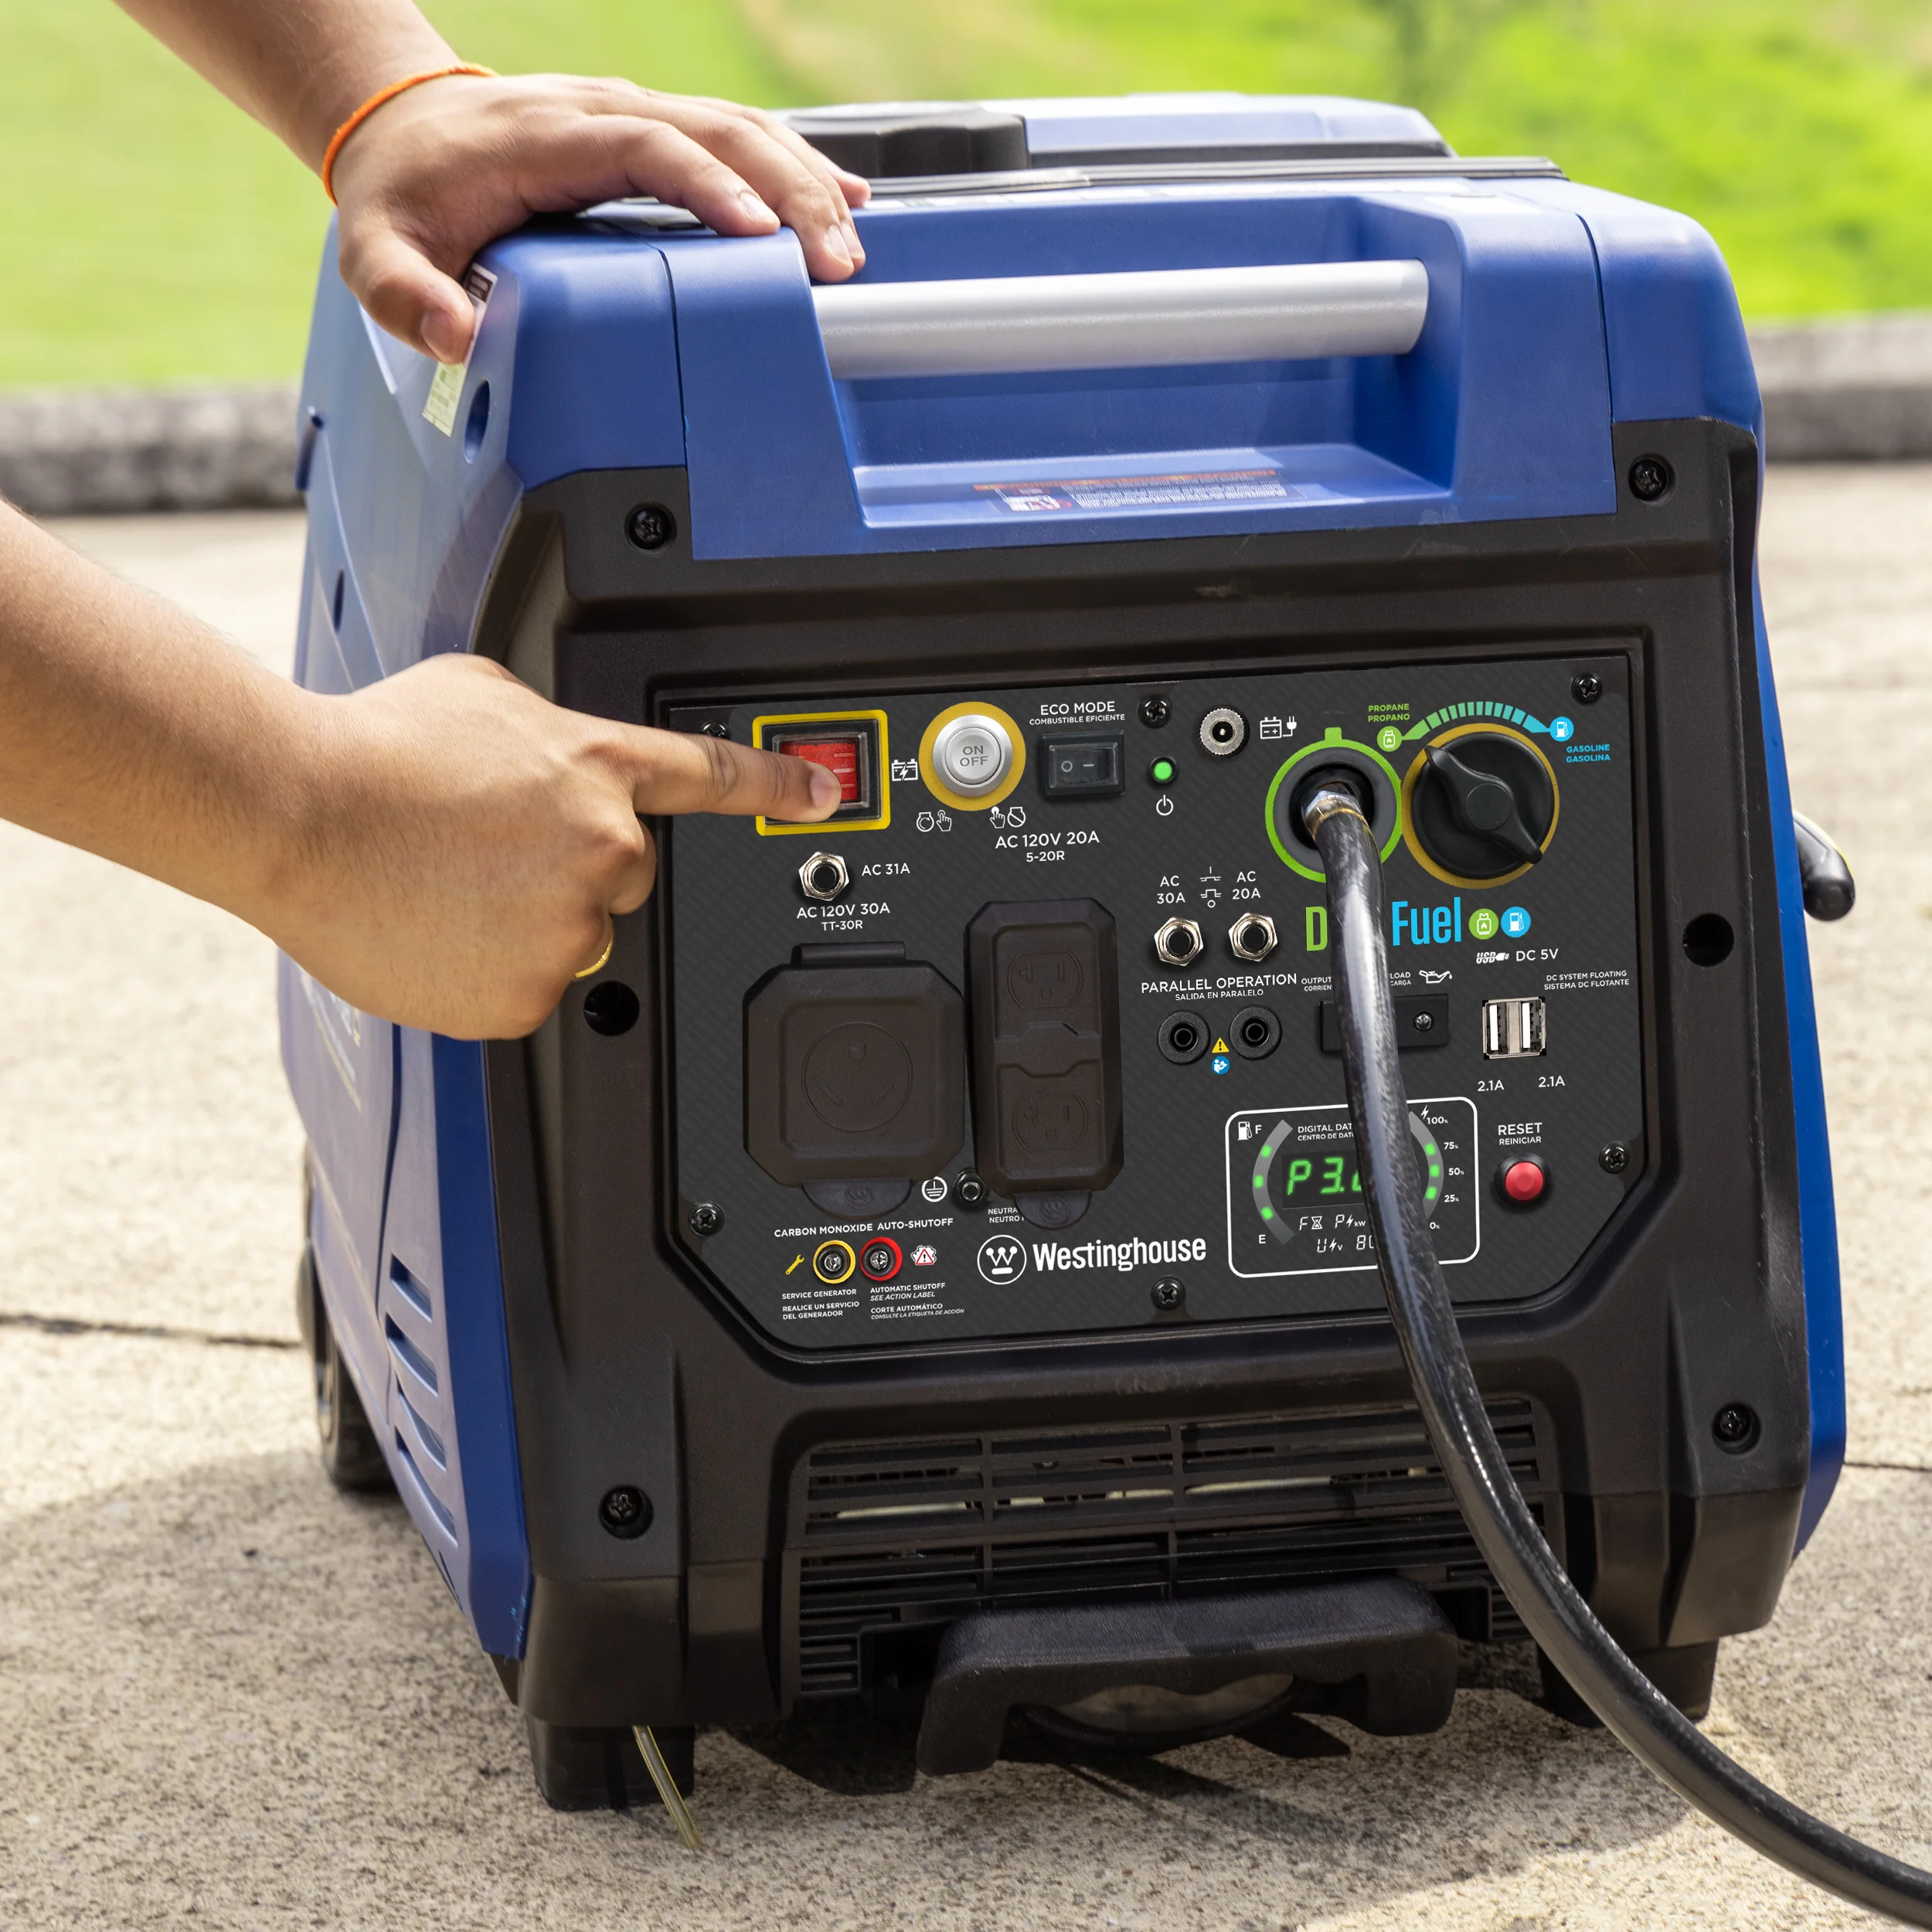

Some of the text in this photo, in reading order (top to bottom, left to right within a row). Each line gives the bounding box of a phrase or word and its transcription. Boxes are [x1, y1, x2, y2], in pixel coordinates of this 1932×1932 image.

[1041, 701, 1115, 715] ECO MODE
[1029, 716, 1083, 725] COMBUSTIBLE
[1369, 713, 1410, 722] PROPANO
[963, 745, 983, 755] ON
[1566, 744, 1609, 753] GASOLINE
[961, 756, 988, 766] OFF
[1566, 754, 1611, 763] GASOLINA
[995, 831, 1100, 849] AC 120V 20A
[1026, 851, 1064, 862] 5-20R
[862, 863, 910, 876] AC 31A
[1160, 876, 1179, 887] AC
[1237, 871, 1256, 883] AC
[1157, 893, 1185, 904] 30A
[1233, 888, 1260, 900] 20A
[797, 903, 890, 918] AC 120V 30A
[821, 920, 862, 930] TT-30R
[1392, 896, 1461, 946] Fuel
[1516, 950, 1536, 961] DC
[1541, 948, 1558, 960] 5V
[1141, 974, 1296, 993] PARALLEL OPERATION
[1478, 1080, 1504, 1091] 2.1A
[1539, 1076, 1565, 1087] 2.1A
[1256, 1125, 1261, 1134] F
[1298, 1124, 1333, 1133] DIGITAL
[1498, 1122, 1542, 1135] RESET
[1499, 1136, 1541, 1145] REINICIAR
[774, 1218, 953, 1237] CARBON MONOXIDE AUTO-SHUTOFF
[1259, 1234, 1266, 1243] E
[1032, 1237, 1206, 1271] Westinghouse
[896, 1303, 943, 1312] AUTOMÁTICO
